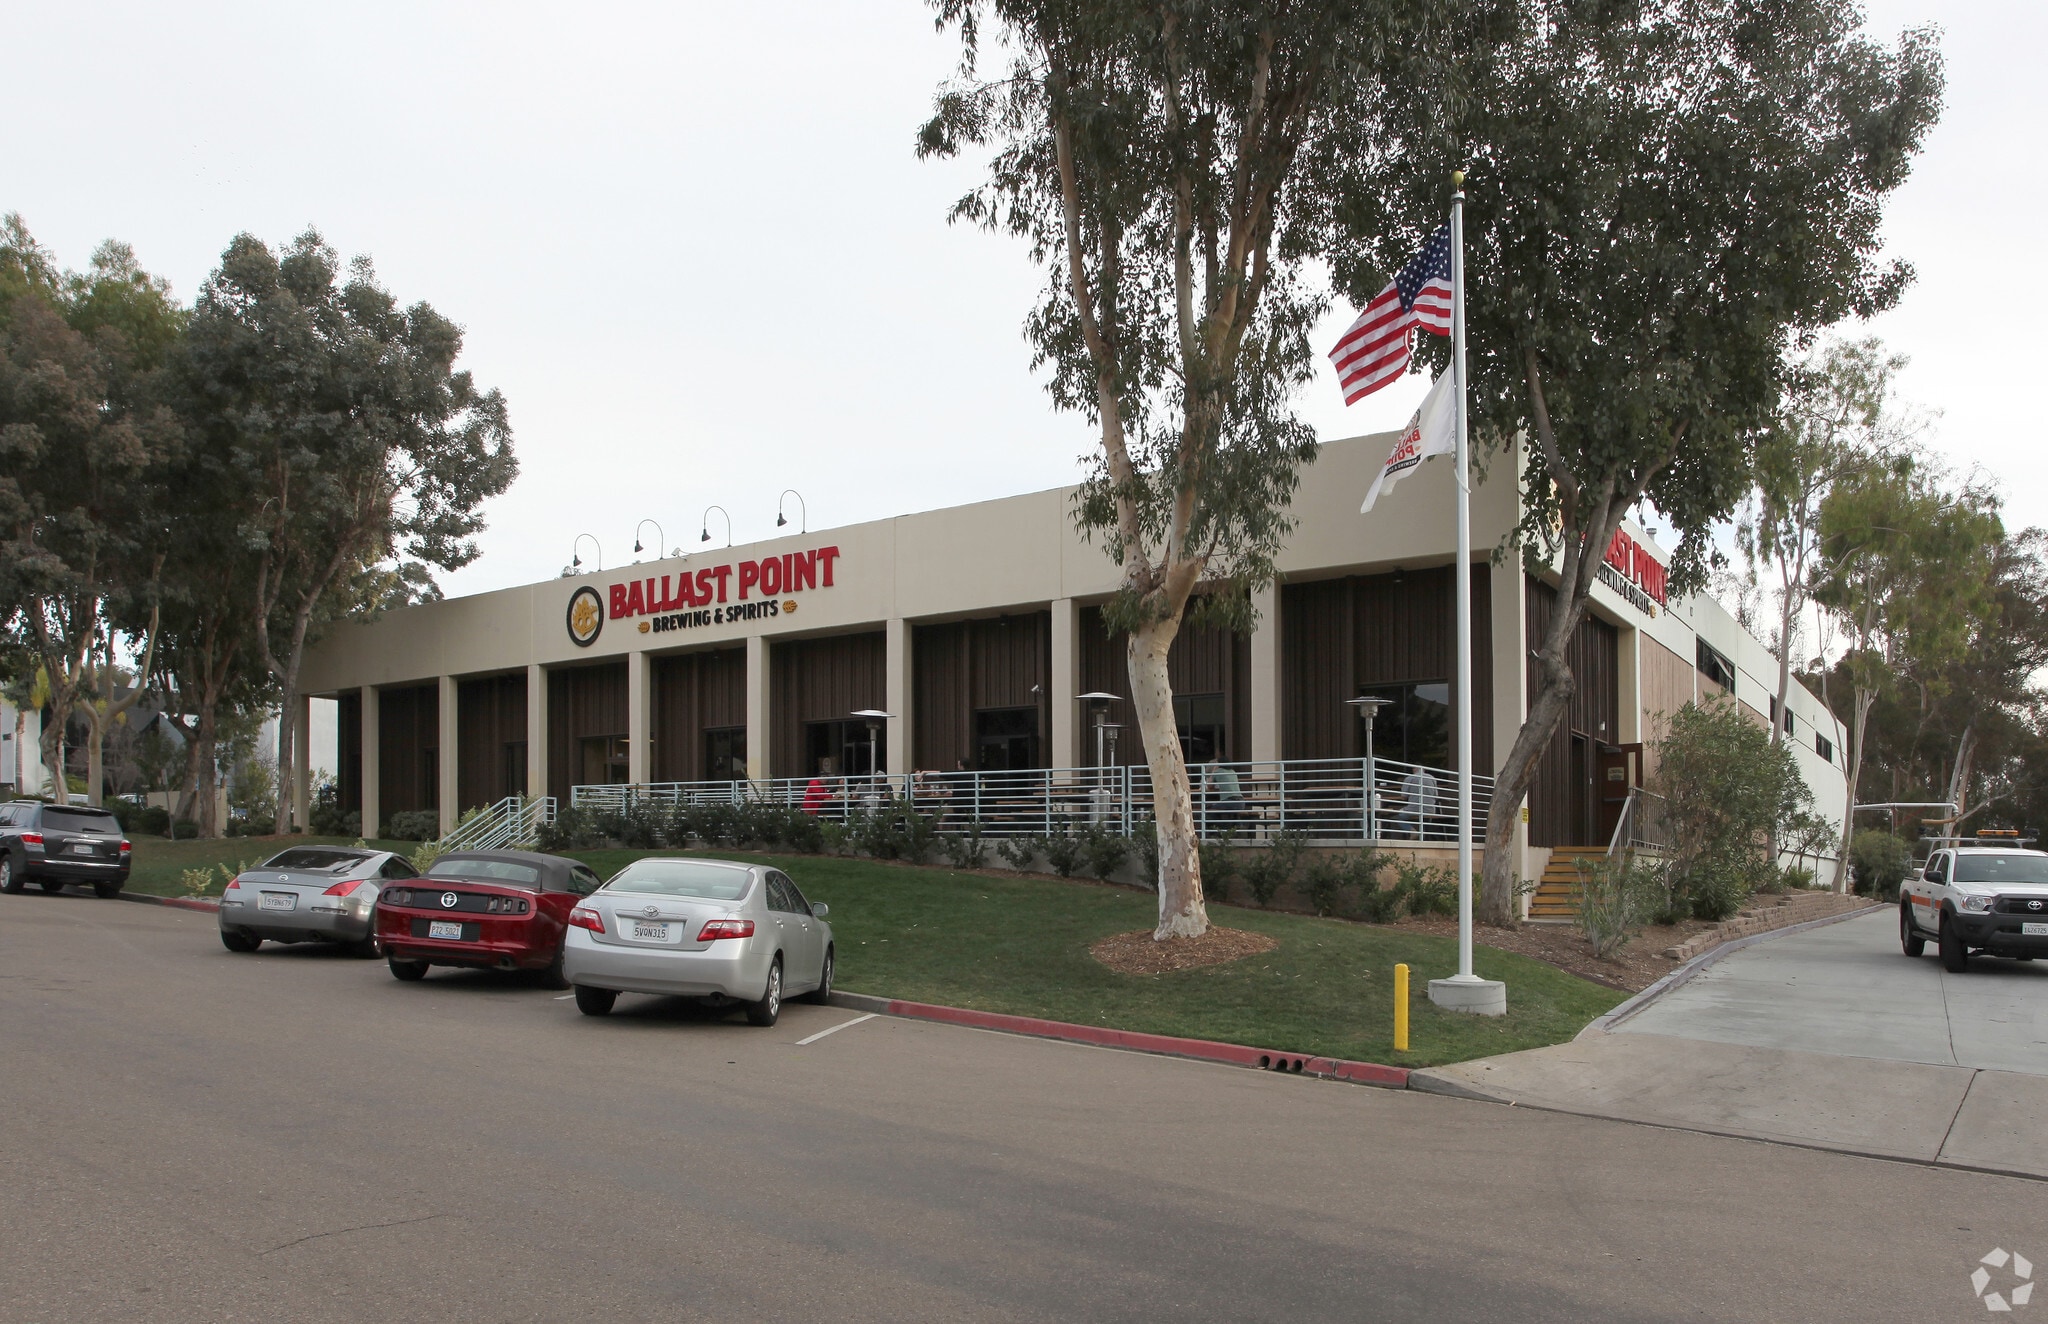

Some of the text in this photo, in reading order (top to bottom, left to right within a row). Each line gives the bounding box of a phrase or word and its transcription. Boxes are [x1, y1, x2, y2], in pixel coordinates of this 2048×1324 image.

[609, 546, 840, 619] BALLAST POINT
[1633, 541, 1668, 606] POINT
[653, 600, 779, 633] BREWING & SPIRITS
